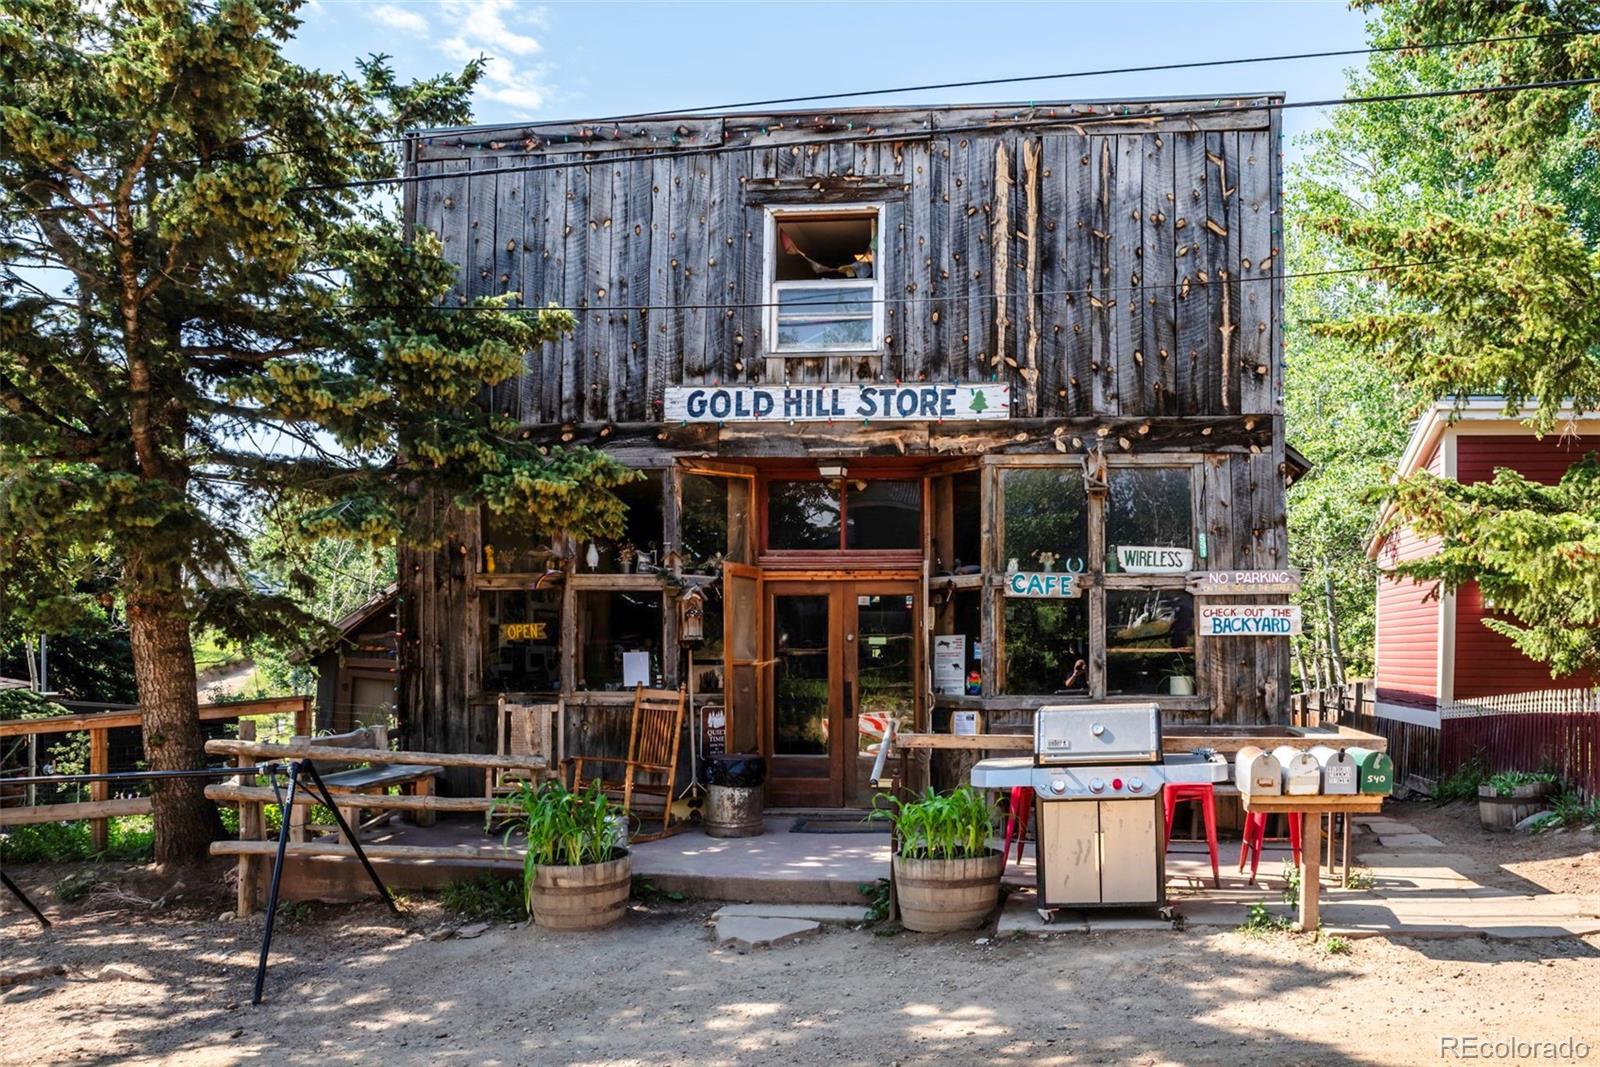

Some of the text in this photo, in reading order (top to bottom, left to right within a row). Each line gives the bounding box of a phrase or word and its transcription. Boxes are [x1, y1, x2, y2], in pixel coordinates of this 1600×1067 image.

[687, 388, 957, 418] GOLD HILL STORE
[1124, 550, 1183, 567] WIRELESS
[1011, 573, 1073, 596] CAFE
[1209, 572, 1290, 584] NO PARKING
[1202, 608, 1292, 618] CHECK OUT THE
[507, 624, 538, 640] OPEN
[1212, 617, 1291, 634] BACKYARD
[1367, 775, 1386, 784] 540
